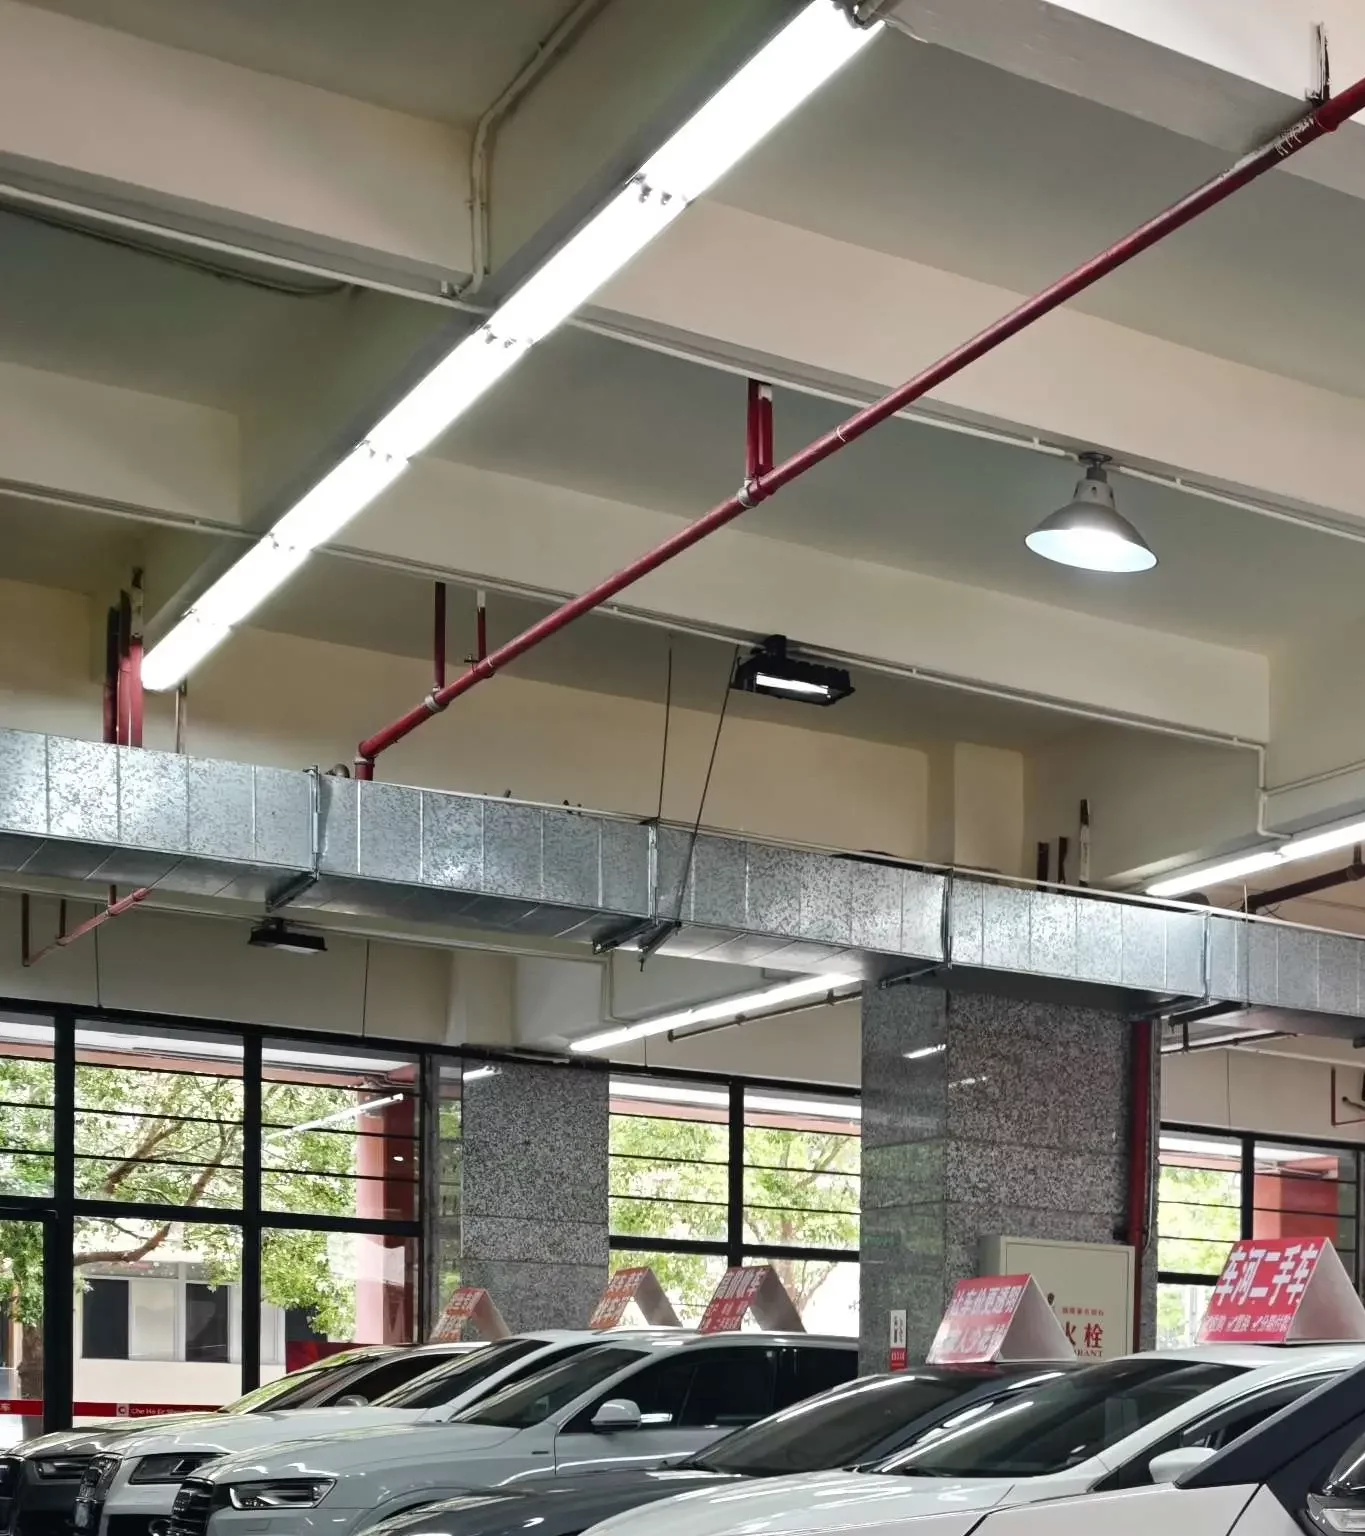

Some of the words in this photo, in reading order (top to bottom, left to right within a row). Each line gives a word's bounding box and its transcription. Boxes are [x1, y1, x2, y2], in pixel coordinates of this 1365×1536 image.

[1215, 1243, 1319, 1306] 车河二手车
